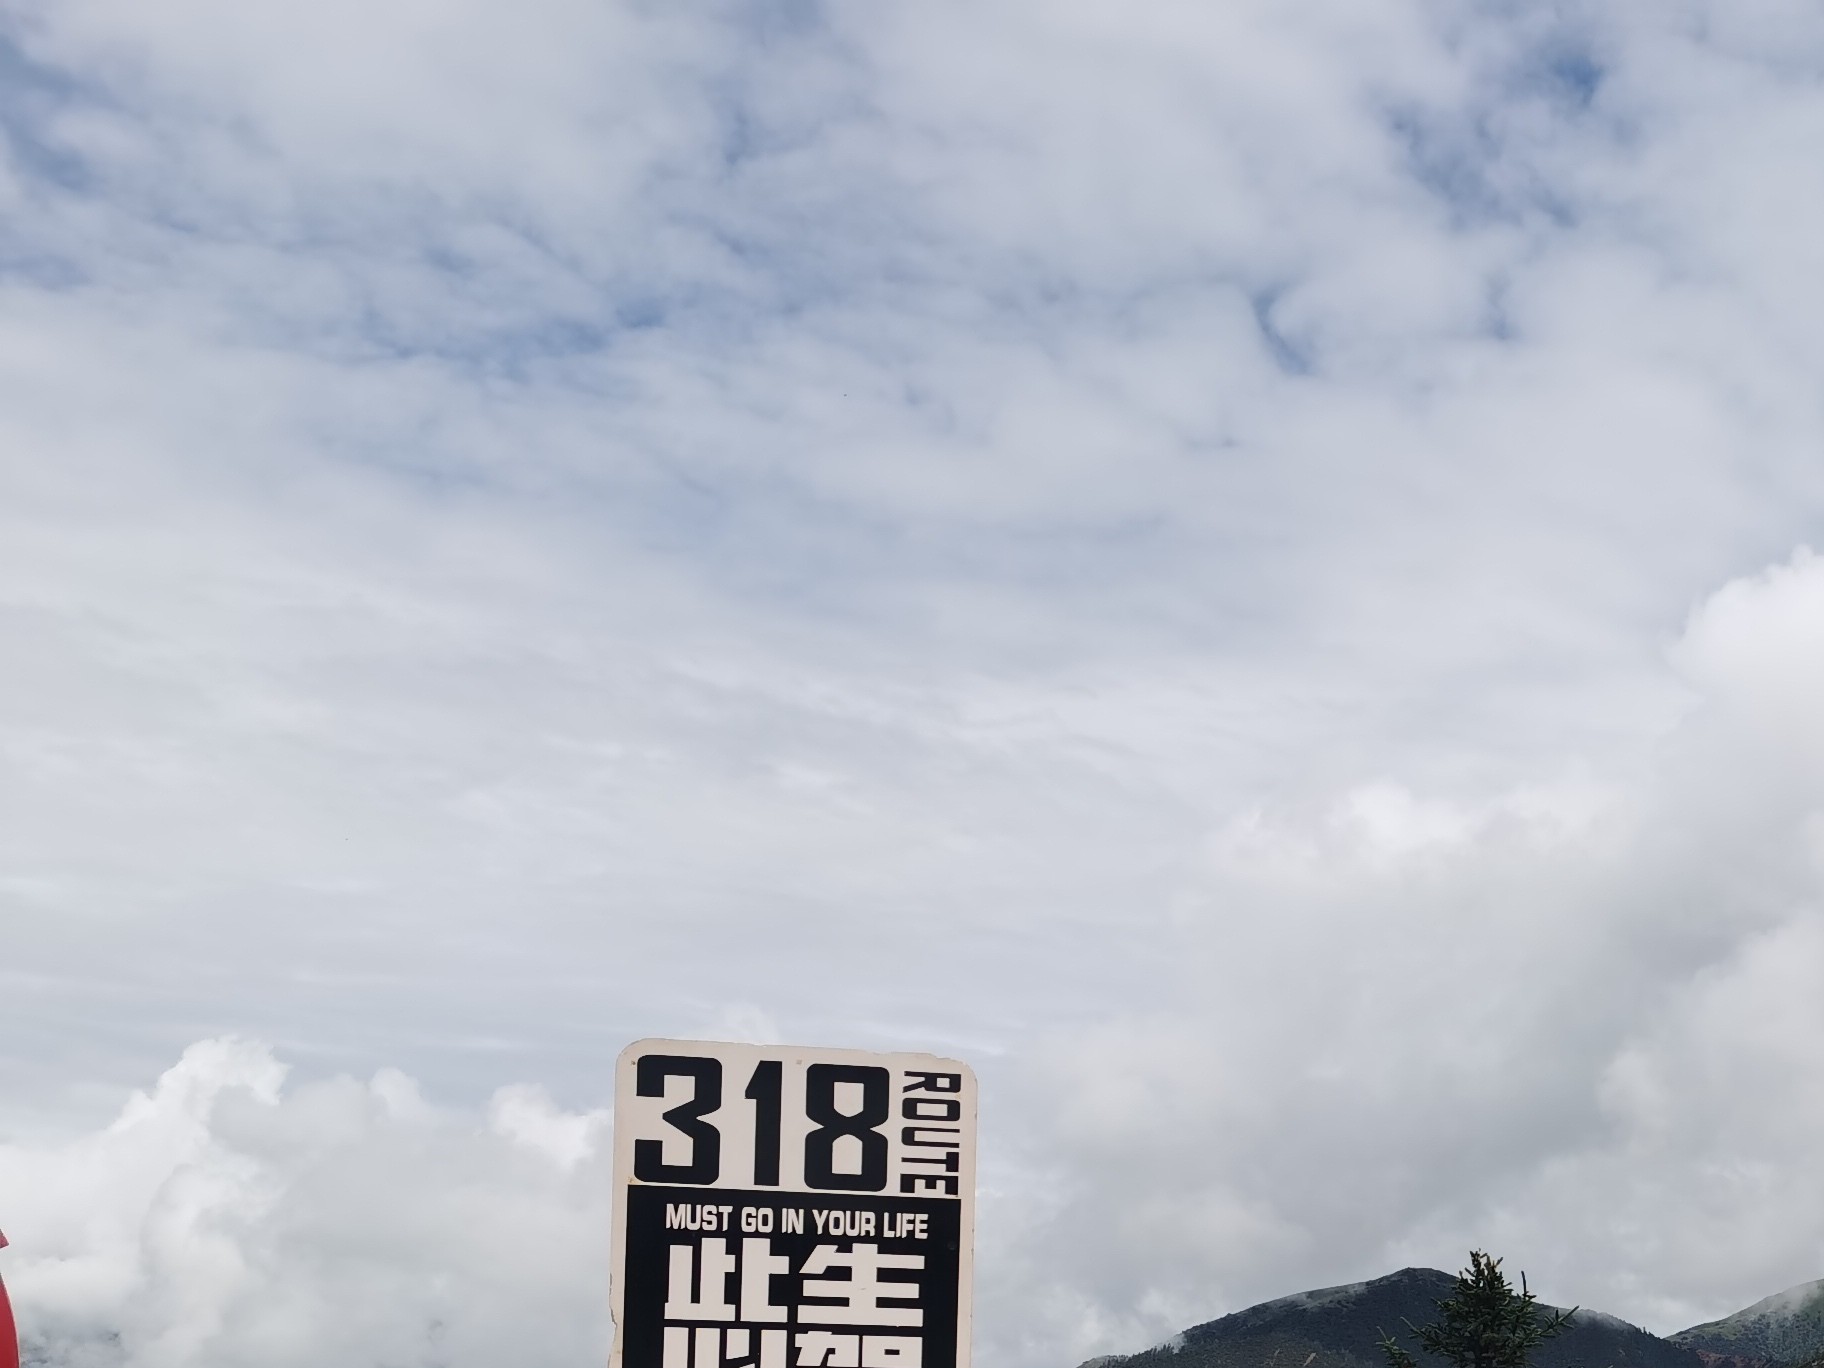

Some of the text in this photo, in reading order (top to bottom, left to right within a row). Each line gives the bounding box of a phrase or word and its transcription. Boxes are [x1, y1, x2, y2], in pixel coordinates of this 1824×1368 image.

[633, 1054, 891, 1193] 318
[899, 1069, 962, 1199] ROUTE
[665, 1203, 929, 1240] MUST GO IN YOUR LIFE
[663, 1236, 926, 1328] 此生
